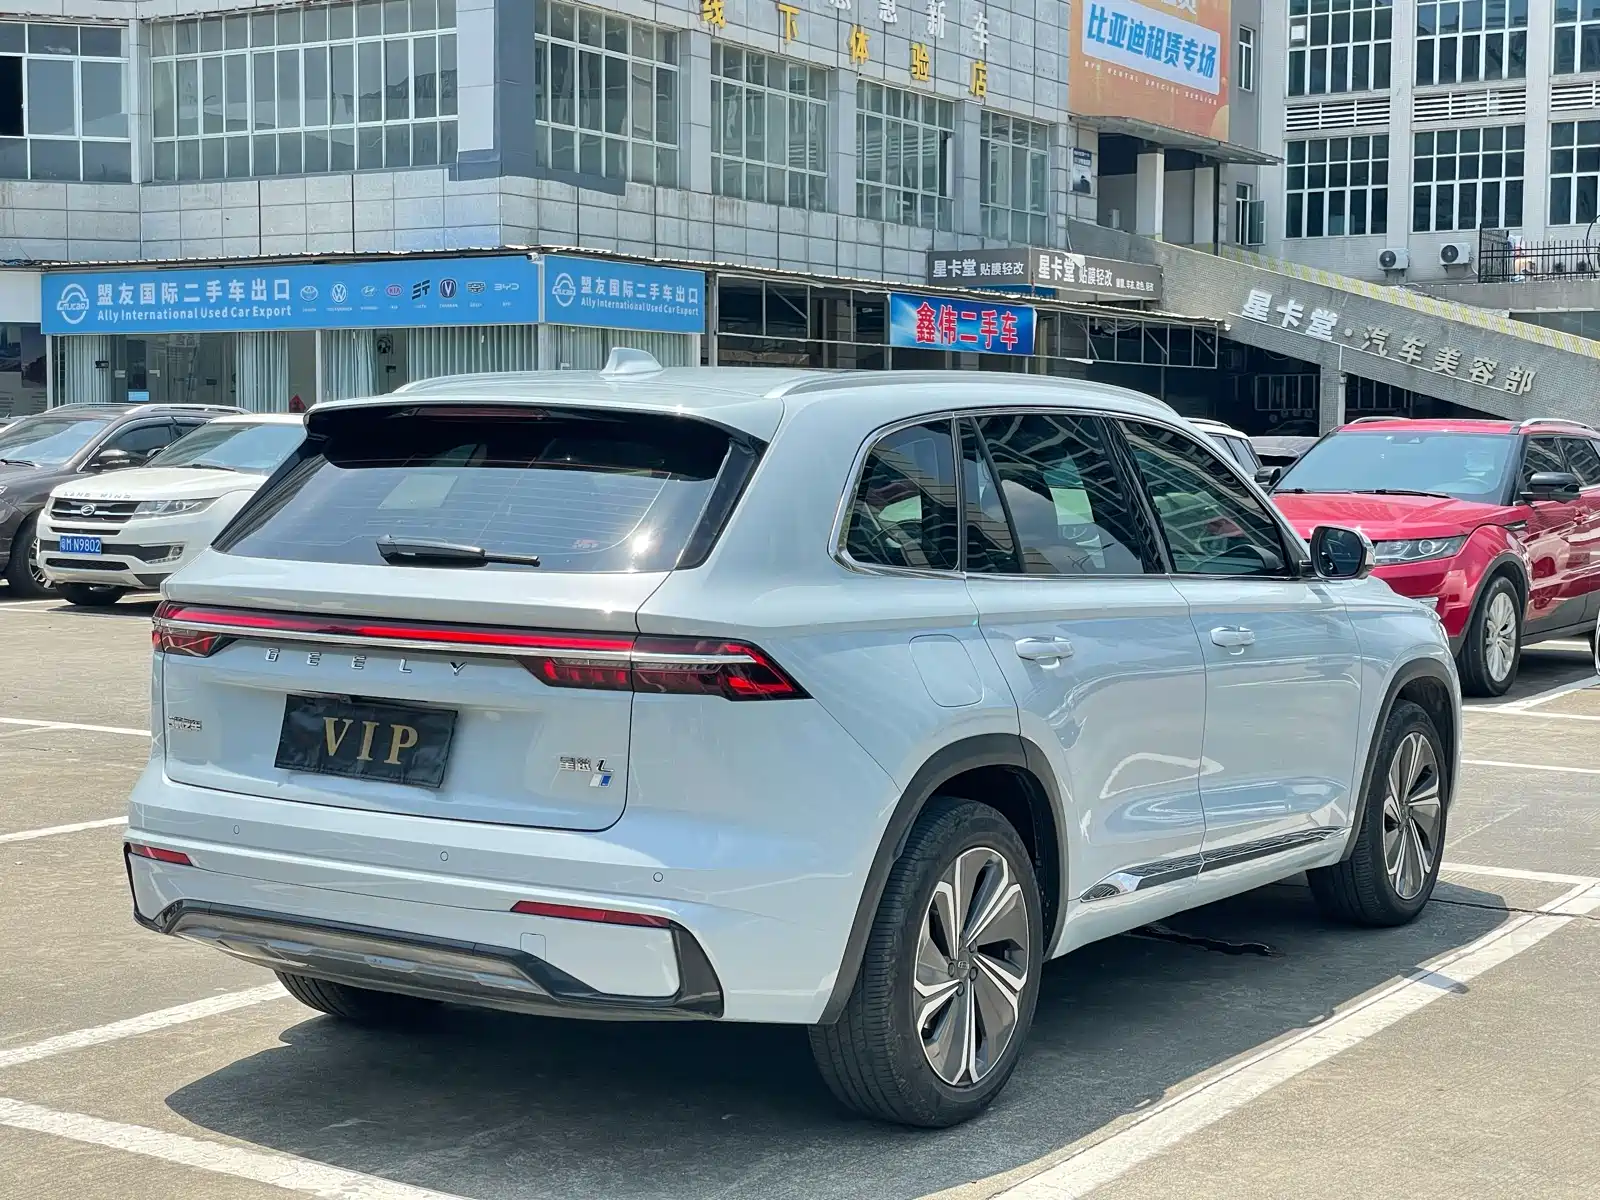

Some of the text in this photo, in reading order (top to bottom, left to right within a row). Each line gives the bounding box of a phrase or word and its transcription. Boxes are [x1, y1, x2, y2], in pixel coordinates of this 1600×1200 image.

[701, 0, 987, 97] 线下体验店
[1086, 3, 1217, 79] 比亚迪租赁专场
[933, 258, 1025, 278] 星卡堂 贴膜轻改
[1038, 255, 1076, 283] 星卡堂
[1078, 265, 1113, 287] 贴膜轻改
[97, 278, 290, 306] 盟友国际二手车出口
[580, 276, 698, 304] 盟友国际二手车出口
[97, 309, 119, 324] Ally
[121, 308, 198, 321] International
[200, 306, 228, 319] Used
[230, 306, 250, 318] Car
[252, 305, 292, 319] Export
[581, 297, 699, 317] Ally International Used Car Export
[915, 301, 1019, 351] 鑫伟二手车
[265, 647, 467, 676] GEELY
[322, 716, 418, 765] VIP
